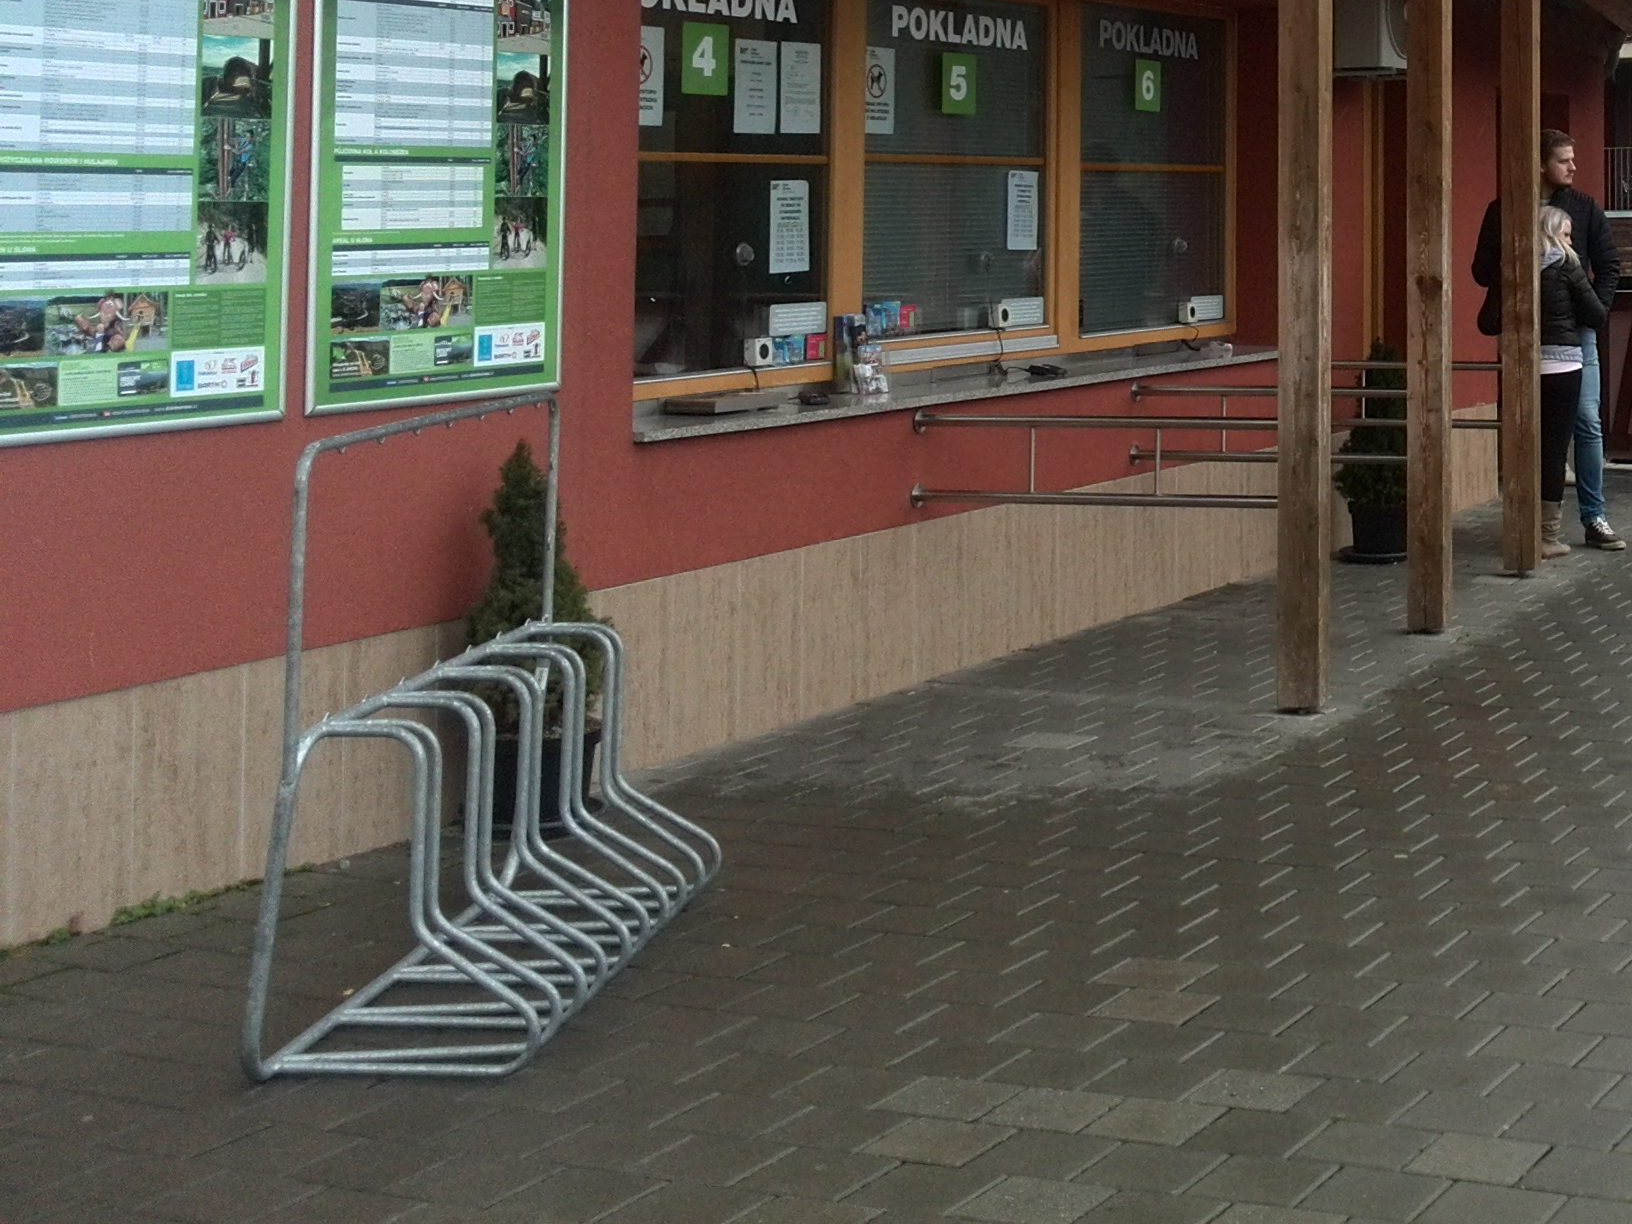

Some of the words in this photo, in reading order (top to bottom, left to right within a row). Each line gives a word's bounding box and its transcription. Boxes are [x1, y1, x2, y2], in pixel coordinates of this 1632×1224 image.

[892, 5, 1028, 50] POKLADNA
[1100, 19, 1198, 60] POKLADNA
[692, 36, 716, 76] 4
[949, 65, 967, 101] 5
[1142, 70, 1154, 101] 6
